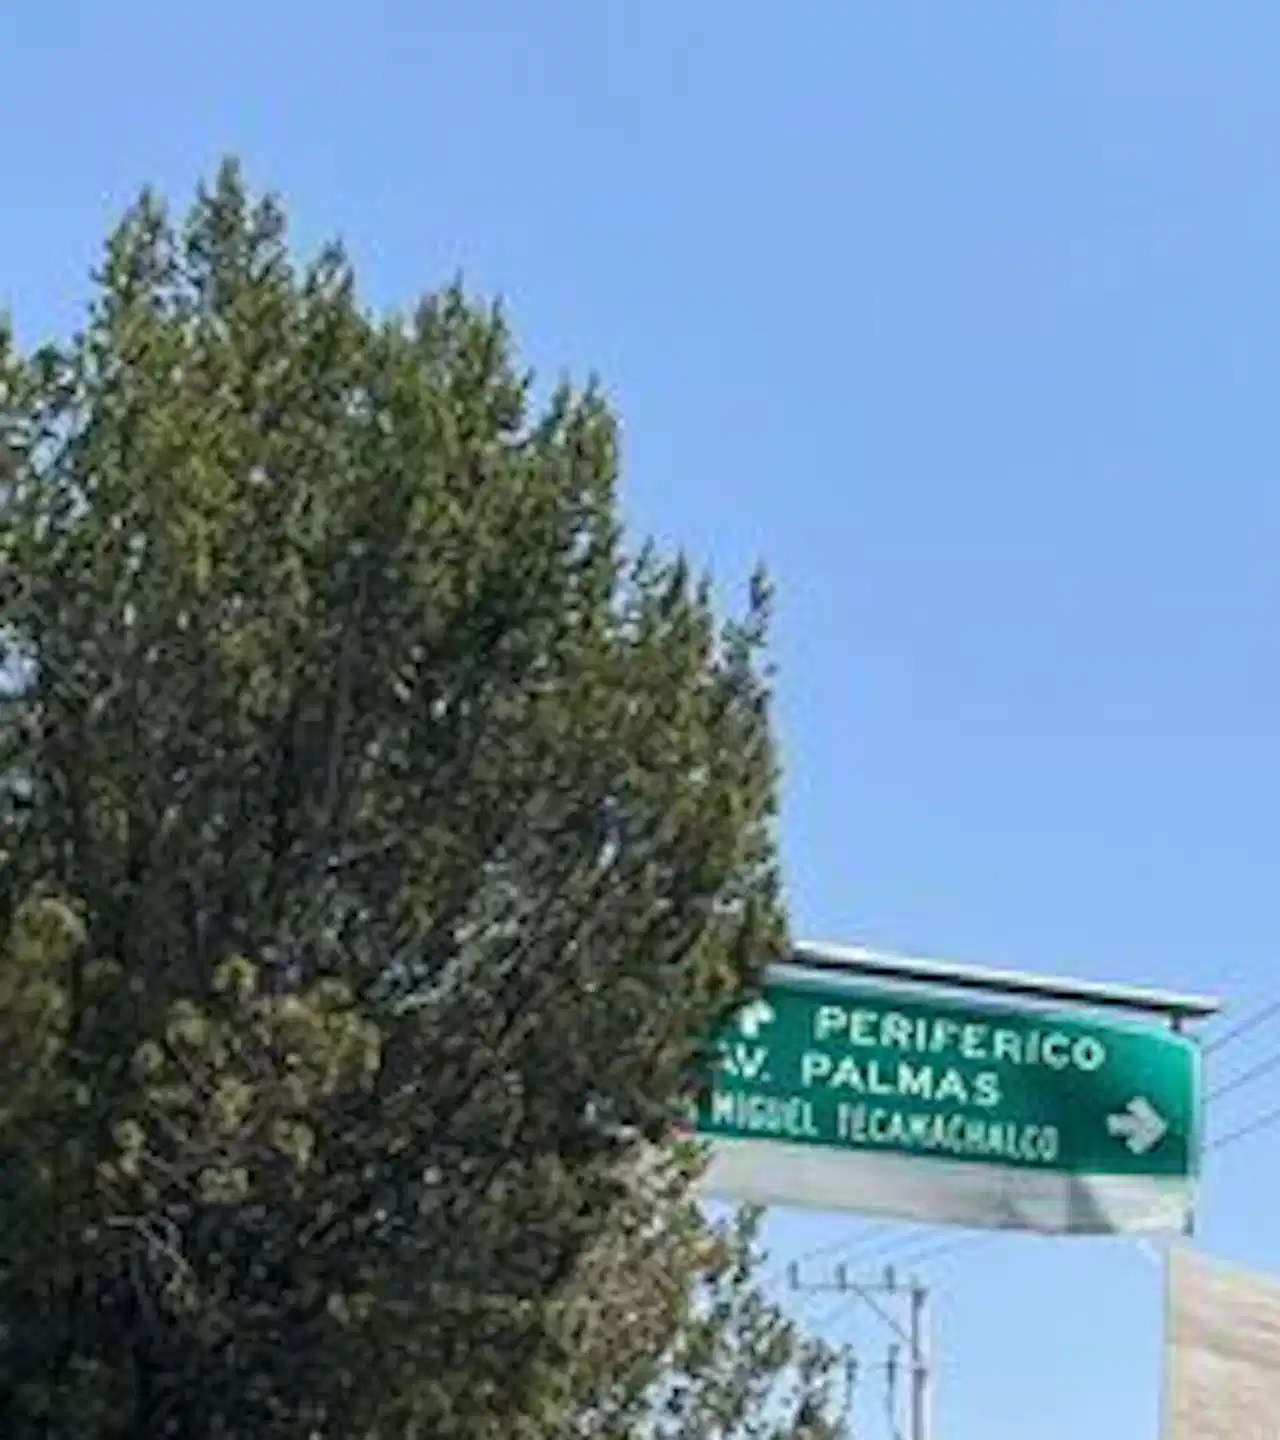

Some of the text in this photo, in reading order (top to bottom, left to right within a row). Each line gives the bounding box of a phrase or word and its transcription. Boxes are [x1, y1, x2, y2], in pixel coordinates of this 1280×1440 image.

[813, 1006, 1103, 1071] PERIFERICO
[801, 1051, 1002, 1106] PALMAS
[711, 1090, 819, 1137] MIGUEL
